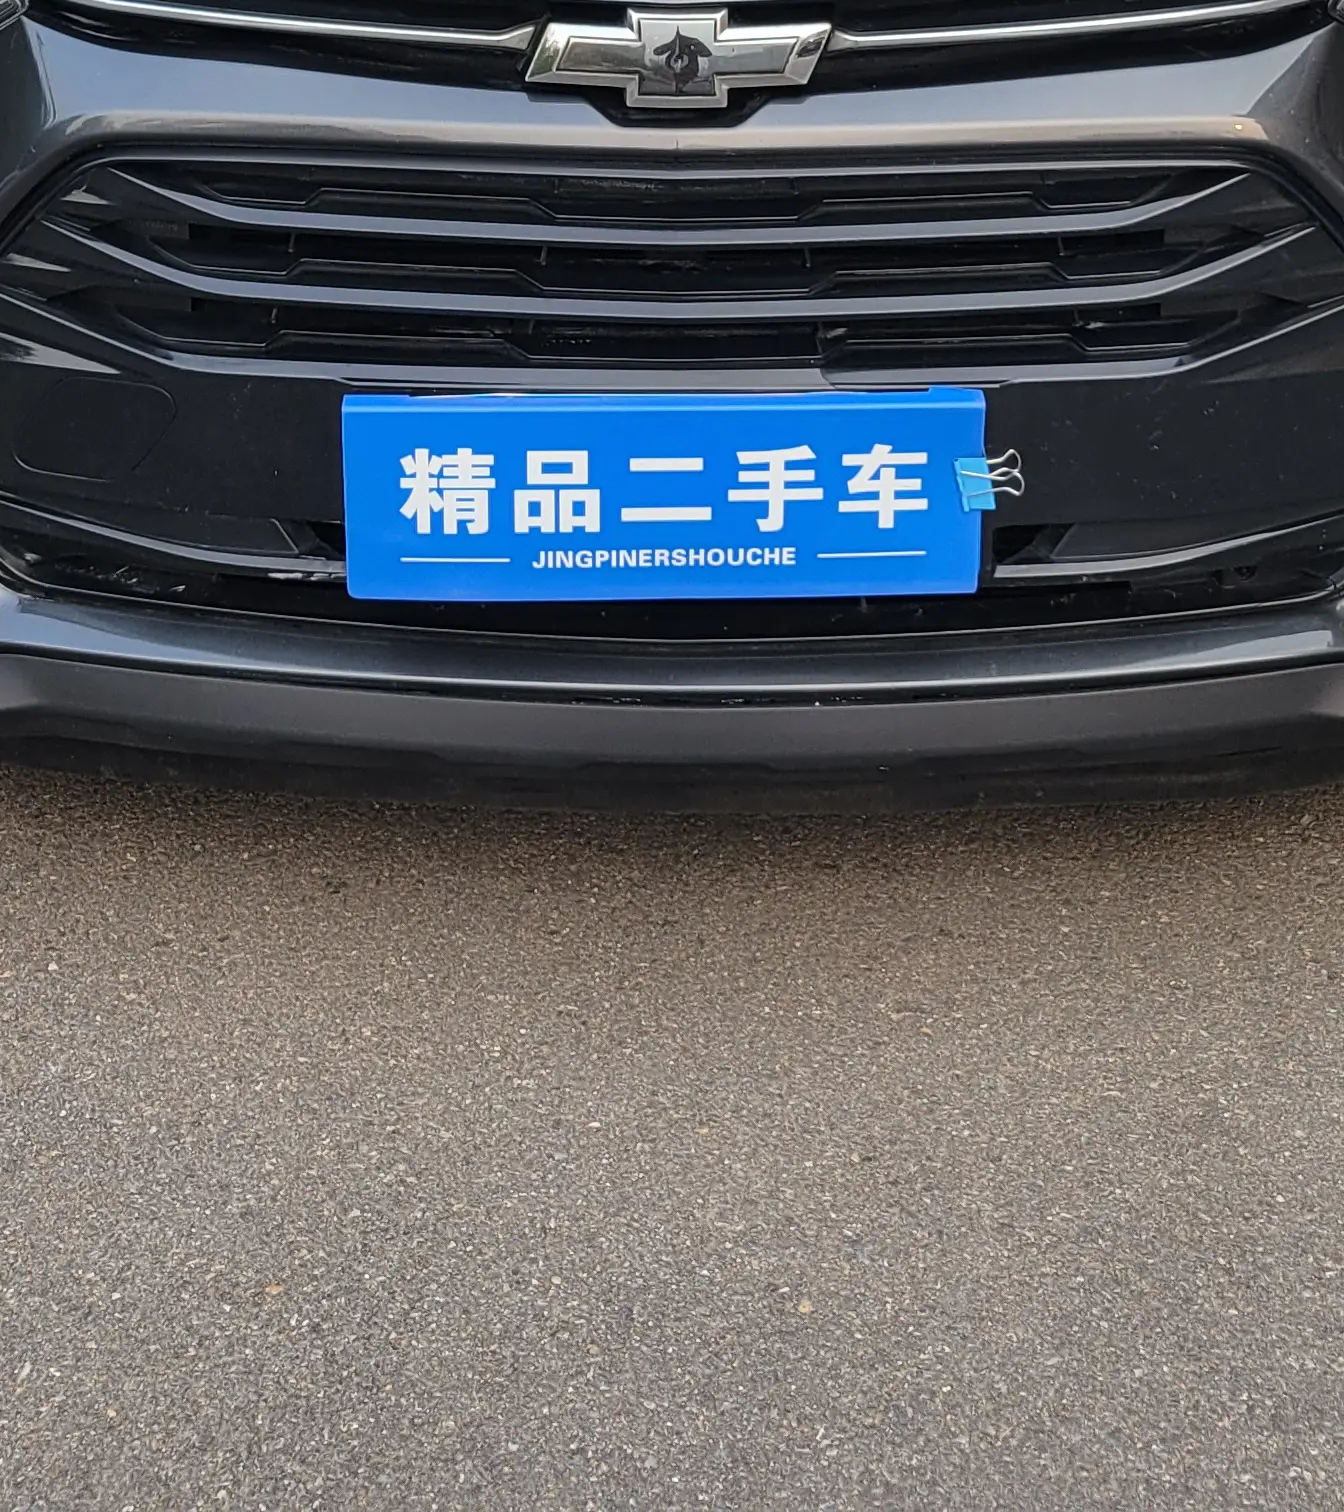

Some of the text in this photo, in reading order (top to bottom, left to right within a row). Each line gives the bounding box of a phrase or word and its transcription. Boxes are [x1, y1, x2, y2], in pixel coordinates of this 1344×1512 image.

[399, 443, 929, 535] 精品二手车
[531, 546, 797, 570] JINGPINERSHOUCHE
